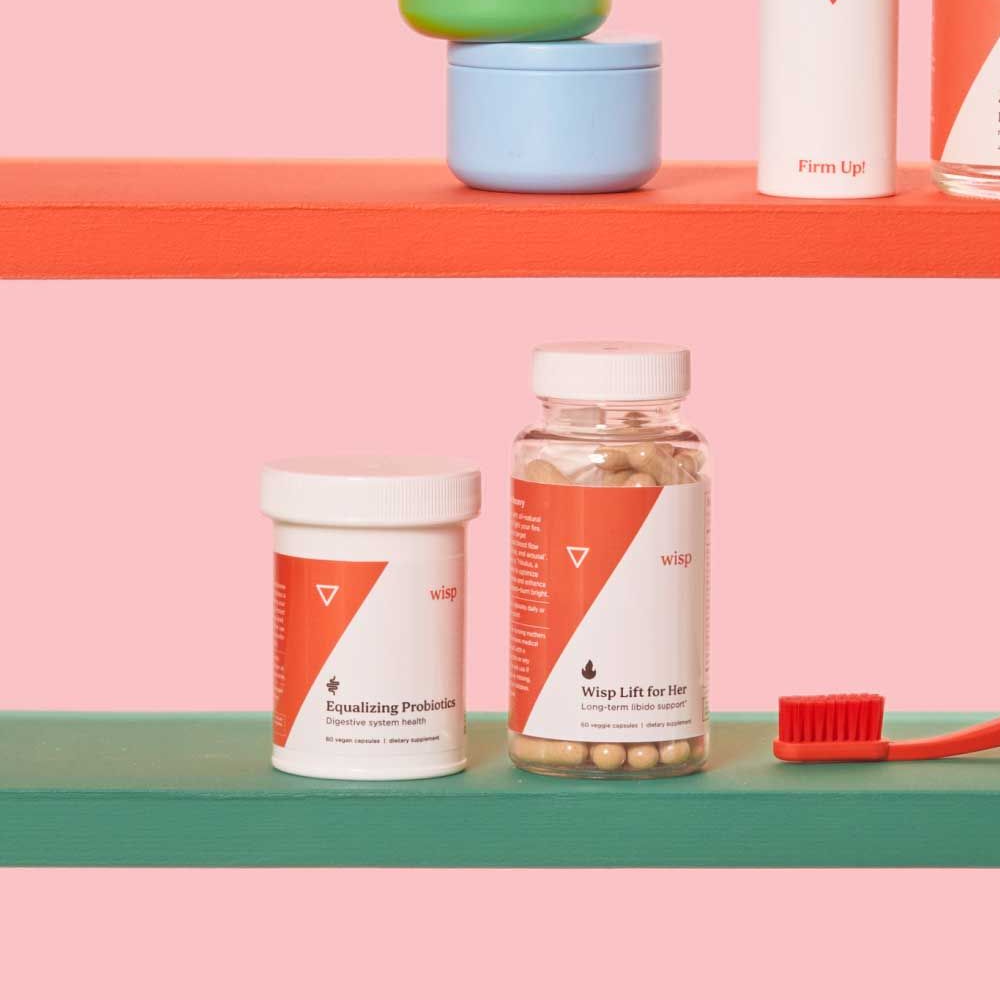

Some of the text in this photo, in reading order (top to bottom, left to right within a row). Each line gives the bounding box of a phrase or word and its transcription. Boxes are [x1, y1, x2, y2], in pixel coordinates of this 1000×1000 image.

[798, 159, 866, 177] Firm Up!
[660, 550, 693, 568] wisp
[429, 584, 457, 602] wisp
[581, 684, 688, 701] Wisp Lift for Her
[326, 697, 456, 716] Equalizing Probiotics
[581, 703, 629, 713] Long-term
[631, 702, 656, 711] libido
[326, 716, 427, 728] Digestive system health
[591, 722, 611, 730] veggie
[612, 722, 638, 730] capsules
[646, 721, 665, 729] dietary
